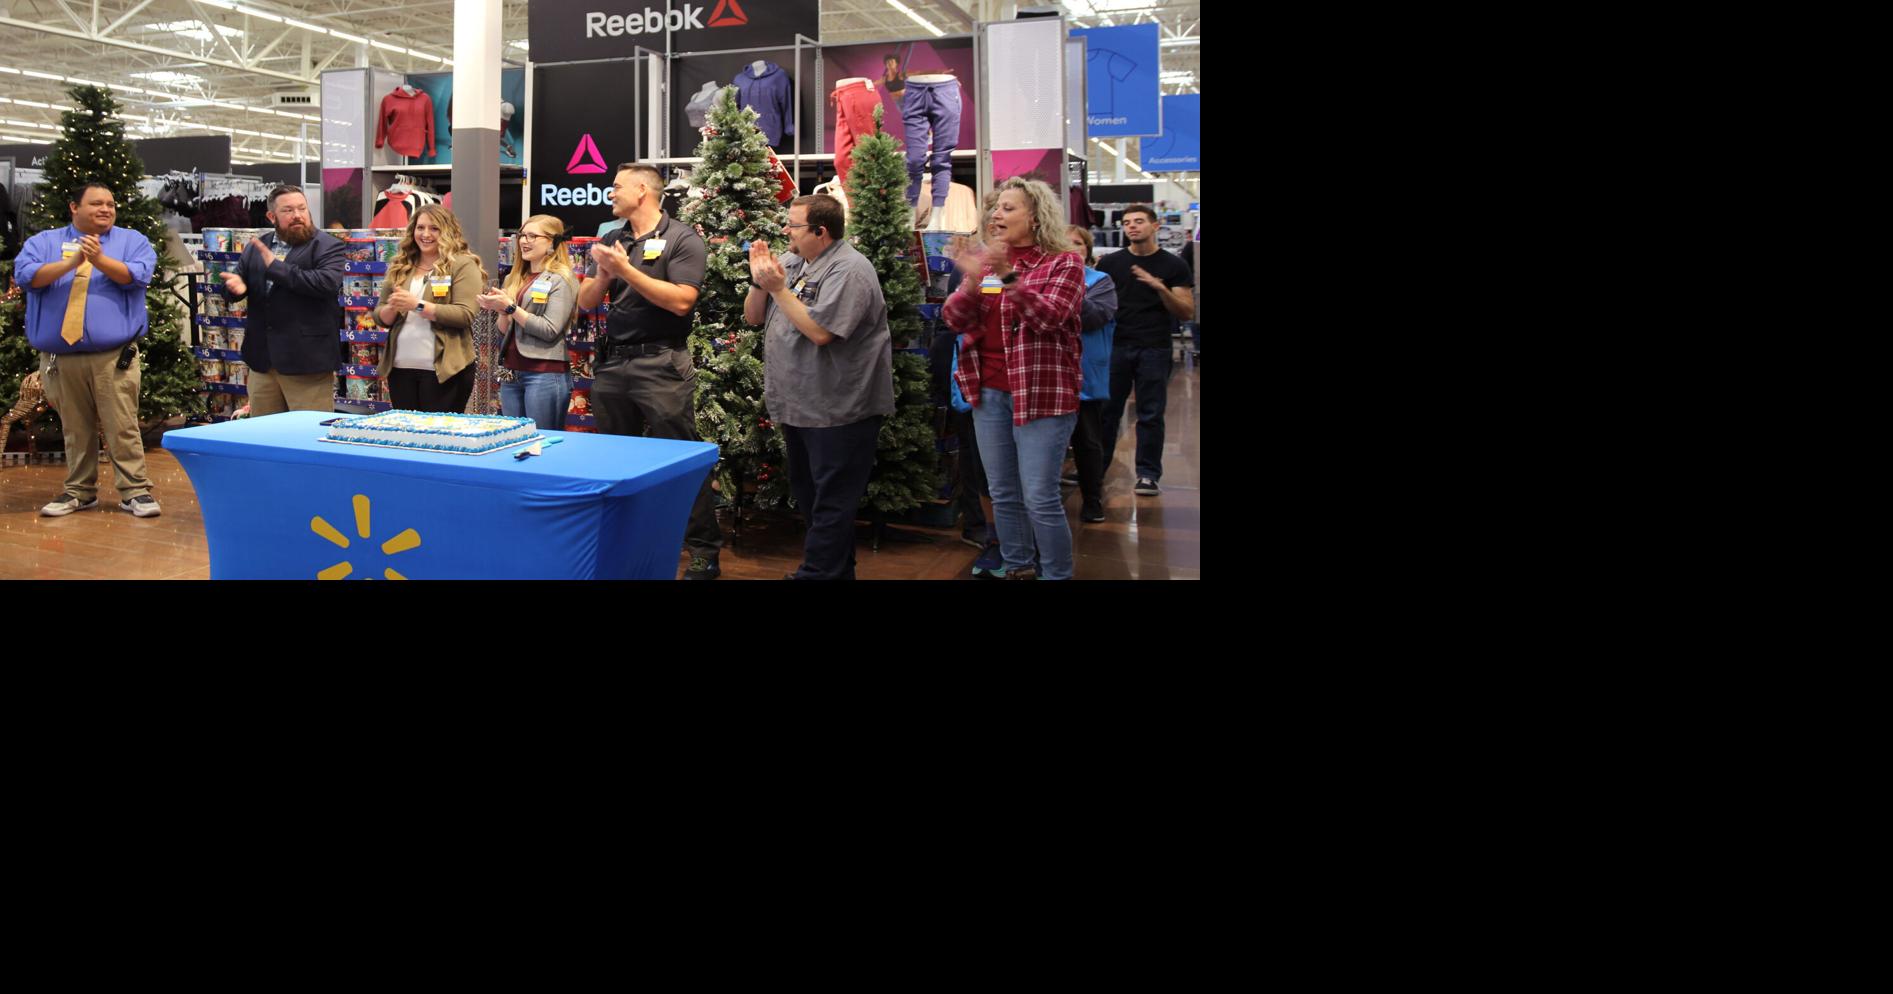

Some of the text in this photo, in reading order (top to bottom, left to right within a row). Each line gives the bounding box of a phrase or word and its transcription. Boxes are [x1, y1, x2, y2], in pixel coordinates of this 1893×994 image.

[586, 4, 704, 38] Reebok
[541, 183, 615, 206] Reebo
[345, 331, 355, 340] $6
[346, 366, 355, 375] $6
